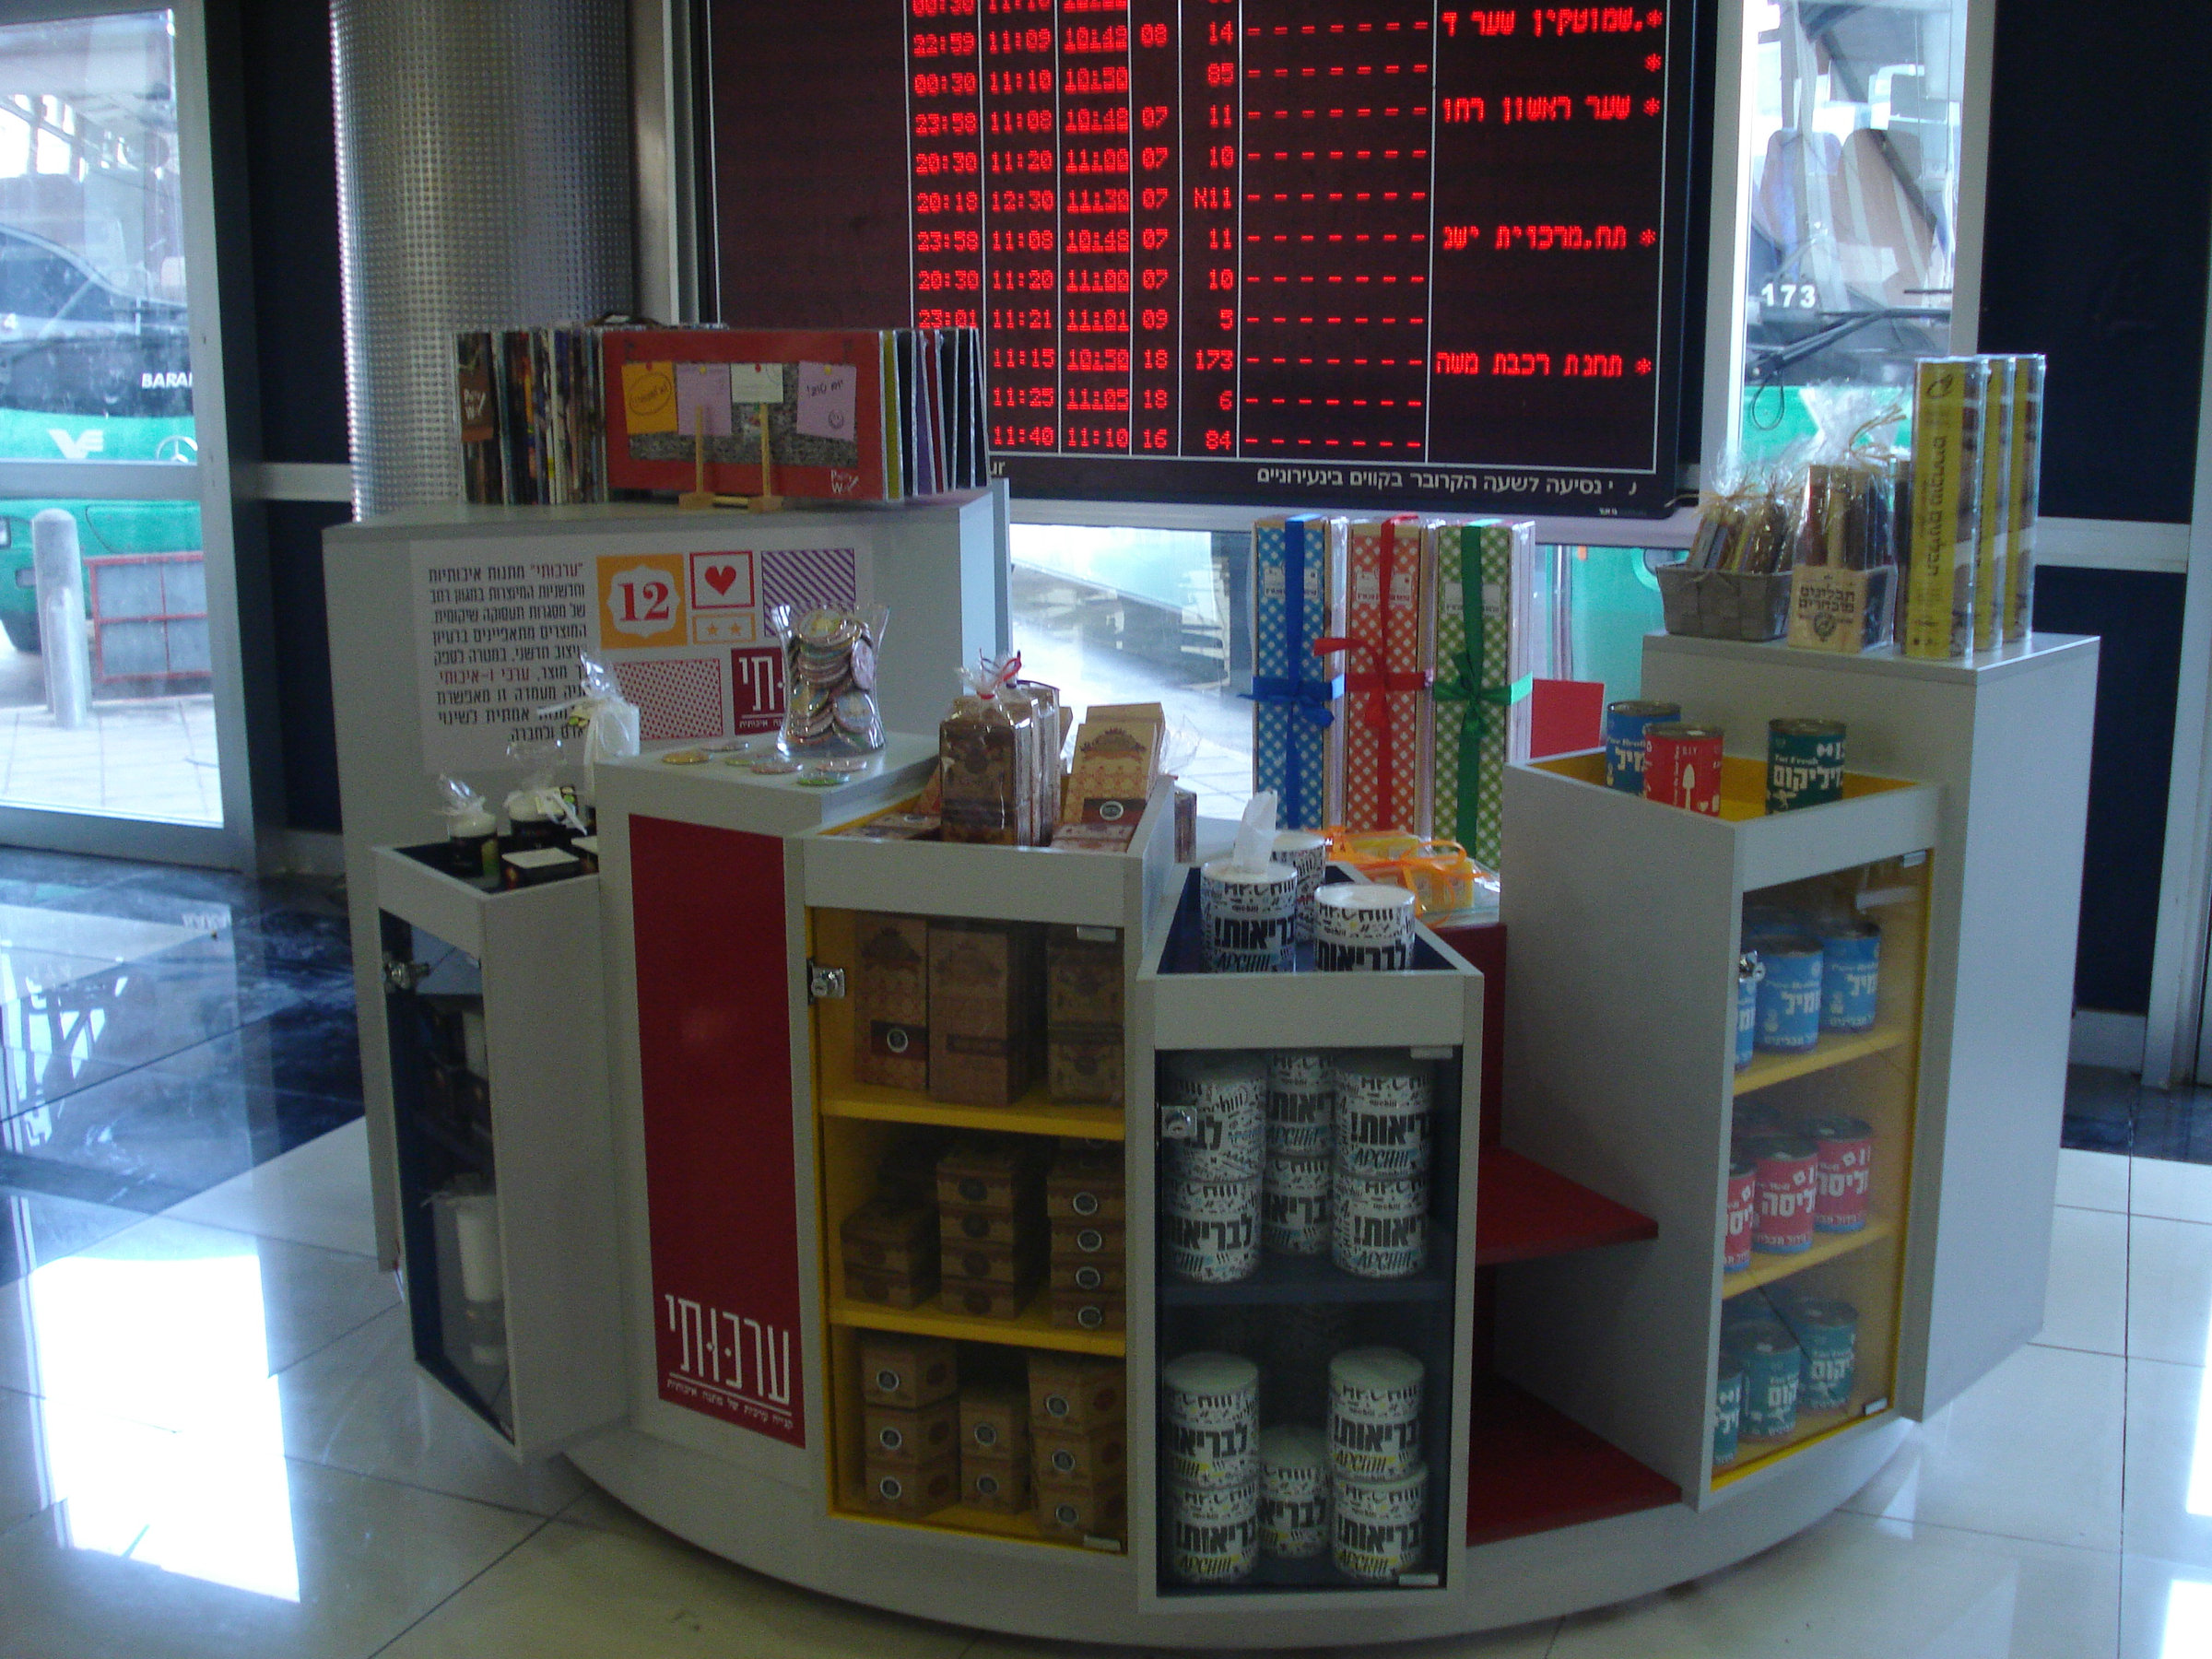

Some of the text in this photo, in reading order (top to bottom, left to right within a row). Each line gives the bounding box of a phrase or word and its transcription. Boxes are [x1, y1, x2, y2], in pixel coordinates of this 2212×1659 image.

[1471, 10, 1515, 36] שער
[989, 29, 1052, 54] 11:09
[1209, 20, 1233, 45] 14
[914, 72, 976, 97] 00:30
[989, 69, 1052, 95] 11:10
[1065, 67, 1128, 95] 10:50
[1141, 106, 1169, 130] 07
[1209, 104, 1232, 129] 11
[1502, 96, 1571, 124] ראשון
[1584, 95, 1631, 121] שער
[915, 145, 1234, 175] 20:30 11:20 11:00 07 10
[992, 190, 1053, 213] 12:30
[1066, 189, 1129, 214] 11:30
[1142, 187, 1169, 210] 07
[1194, 186, 1232, 210] N11
[993, 229, 1053, 251] 11:08
[1066, 229, 1129, 253] 10:48
[1142, 229, 1169, 251] 07
[1209, 228, 1232, 250] 11
[918, 269, 1233, 293] 20:30 11:20 11:00 07 10
[1760, 283, 1816, 309] 173
[919, 309, 1233, 332] 23:01 11:21 11:01 09 5
[994, 347, 1233, 371] 11:15 10:50 18 173
[1435, 351, 1622, 377] תחנת רכבת משה
[994, 387, 1233, 411] 11:25 11:05 18 6
[994, 425, 1231, 451] 11:40 11:10 16 84
[1349, 469, 1404, 491] בקווים
[1546, 477, 1603, 496] נסיעה
[488, 565, 525, 582] מתנות
[429, 588, 451, 605] רחב
[618, 582, 669, 622] 12
[482, 606, 524, 623] תעסוקה
[529, 604, 564, 620] מסגרות
[569, 602, 586, 618] של
[432, 629, 467, 646] ברעיון
[540, 624, 587, 641] המוצרים
[434, 650, 464, 667] לספק
[468, 649, 506, 665] במטרה
[501, 667, 530, 682] ערכי
[514, 686, 556, 701] מעמדה
[563, 684, 587, 700] ניה
[512, 724, 555, 742] ולחברה
